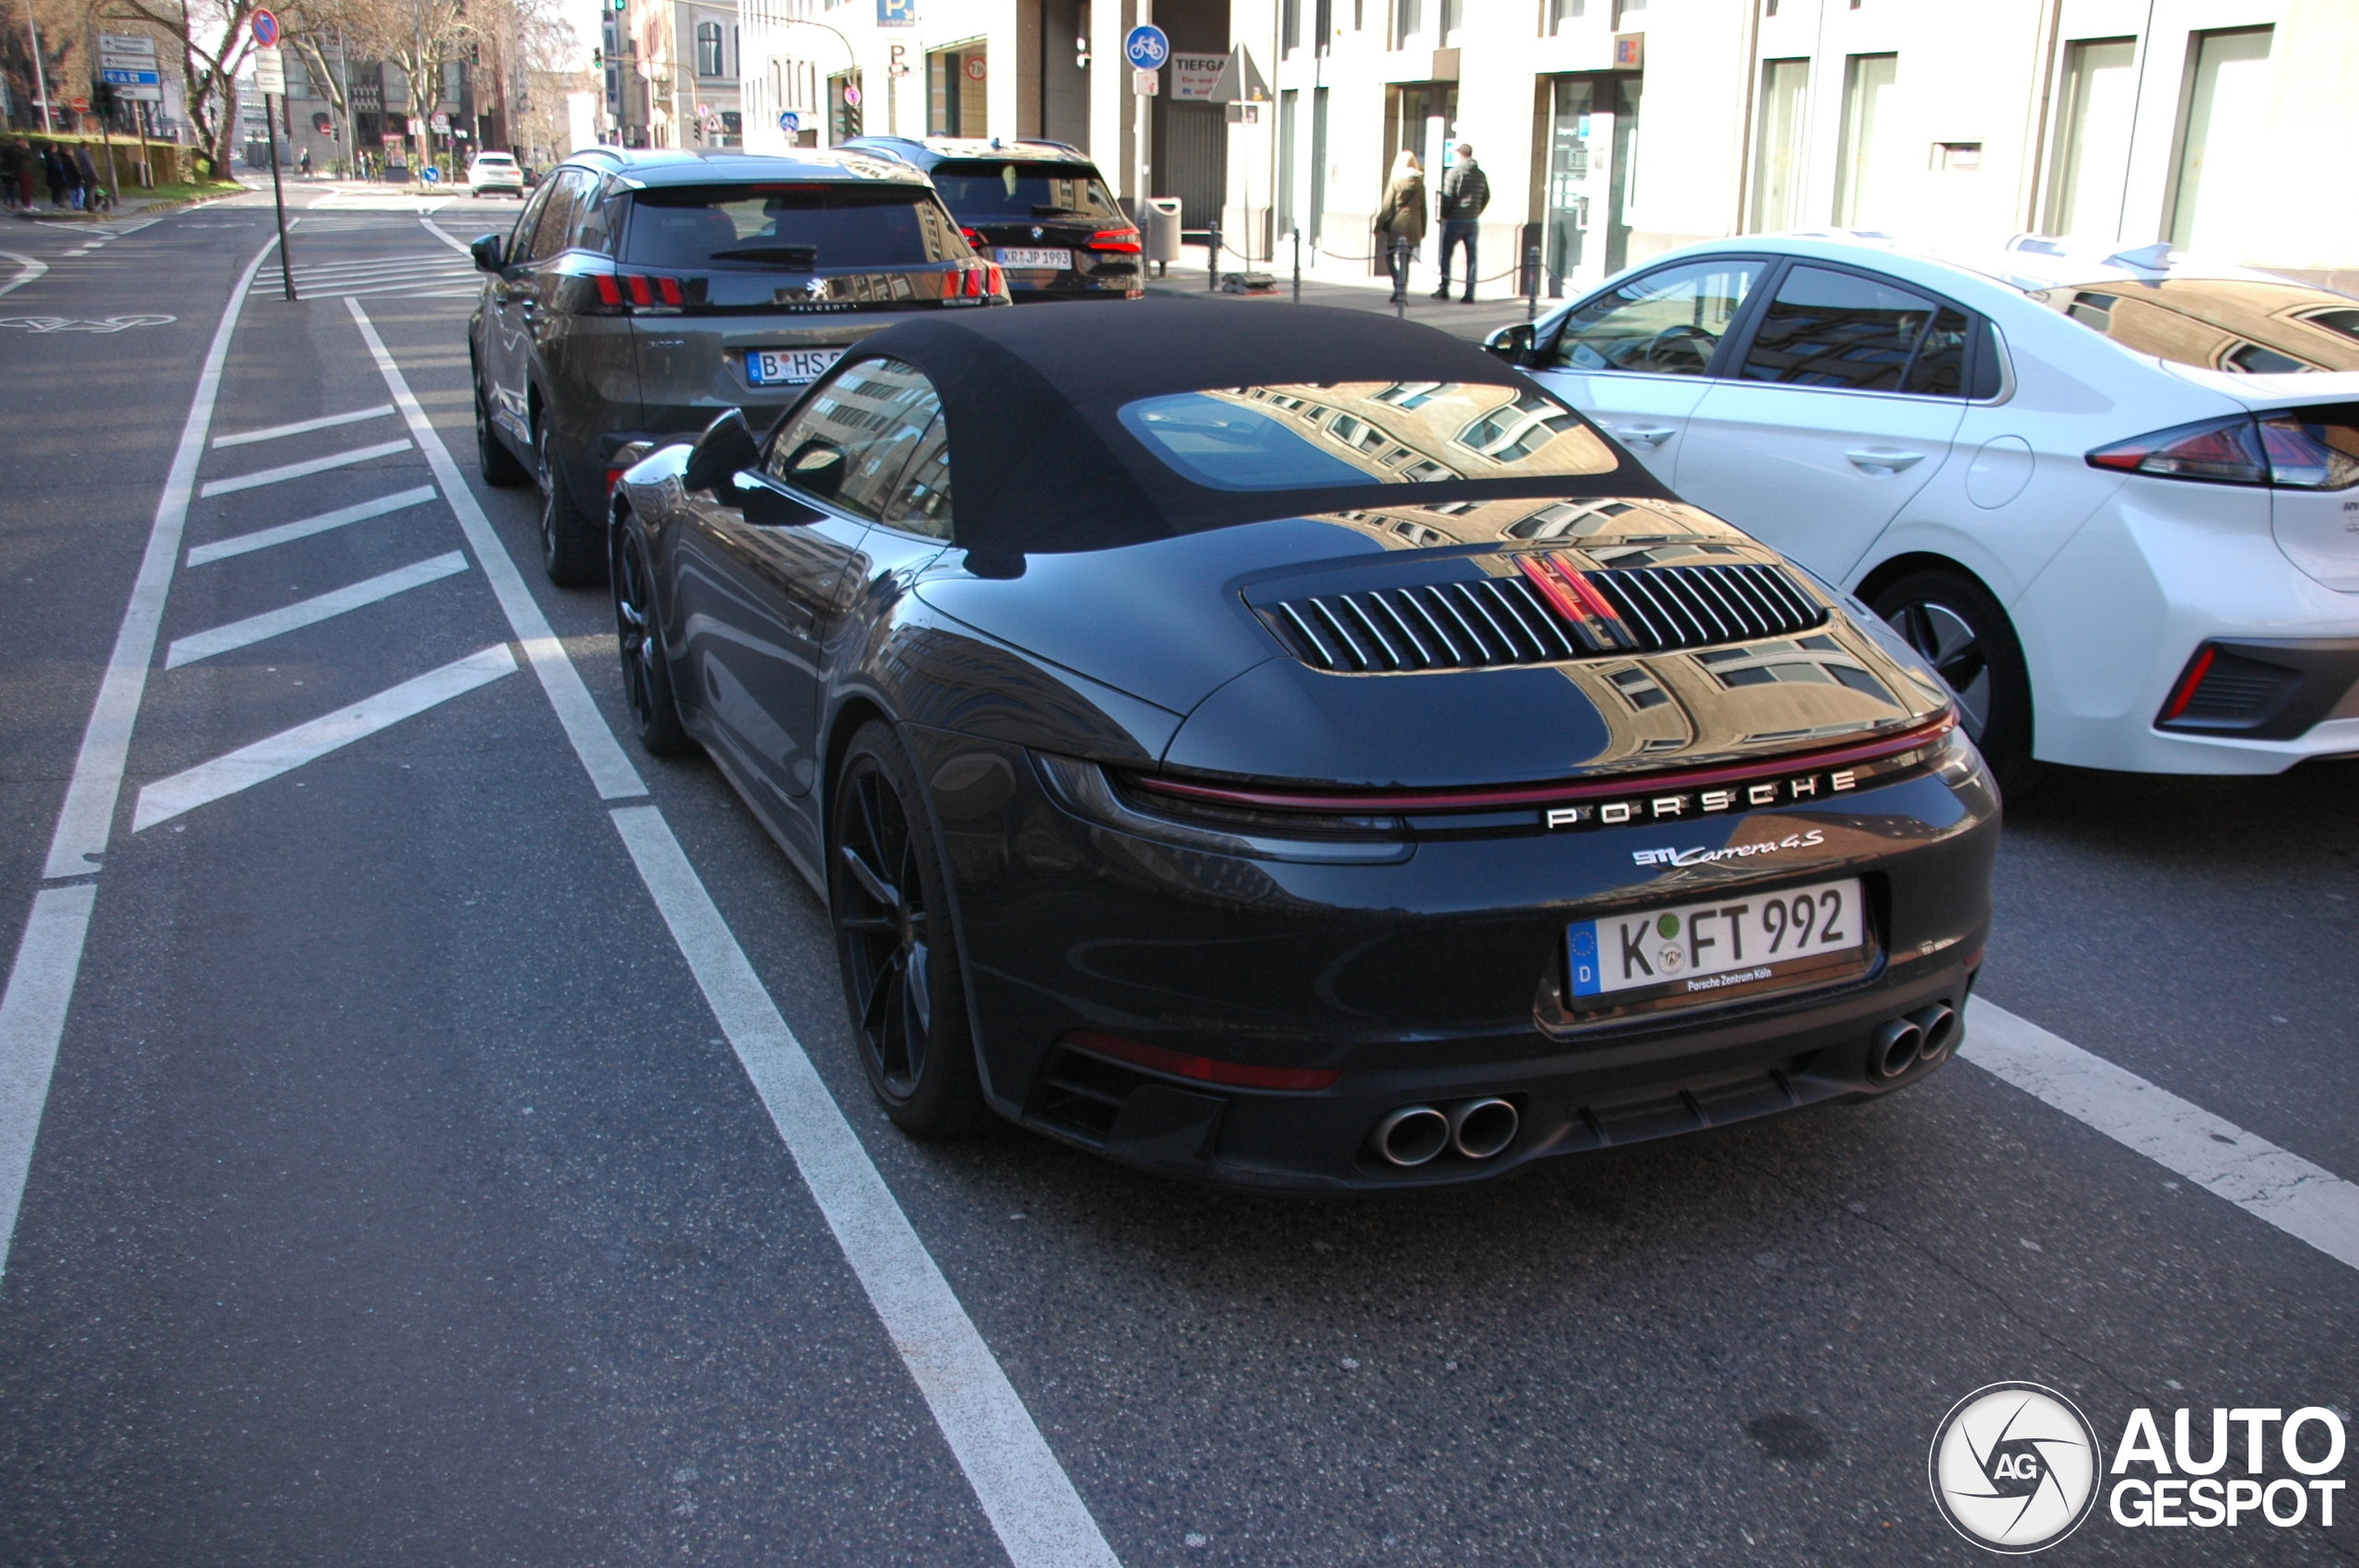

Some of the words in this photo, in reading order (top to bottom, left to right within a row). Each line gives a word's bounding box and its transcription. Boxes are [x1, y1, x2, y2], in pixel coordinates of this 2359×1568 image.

[890, 45, 905, 64] P
[1003, 251, 1018, 264] KR
[1027, 251, 1040, 264] JP
[1043, 252, 1069, 265] 1993
[762, 355, 778, 377] B
[1547, 770, 1856, 828] PORSCHE
[1632, 847, 1677, 866] 911
[1671, 841, 1779, 868] Carrera
[1620, 919, 1655, 979] K
[1688, 904, 1750, 968] FT
[1762, 889, 1845, 954] 992
[1579, 965, 1591, 983] D
[1688, 977, 1720, 992] Porsche
[1721, 972, 1755, 985] Zentrum
[1755, 967, 1773, 979] Köln
